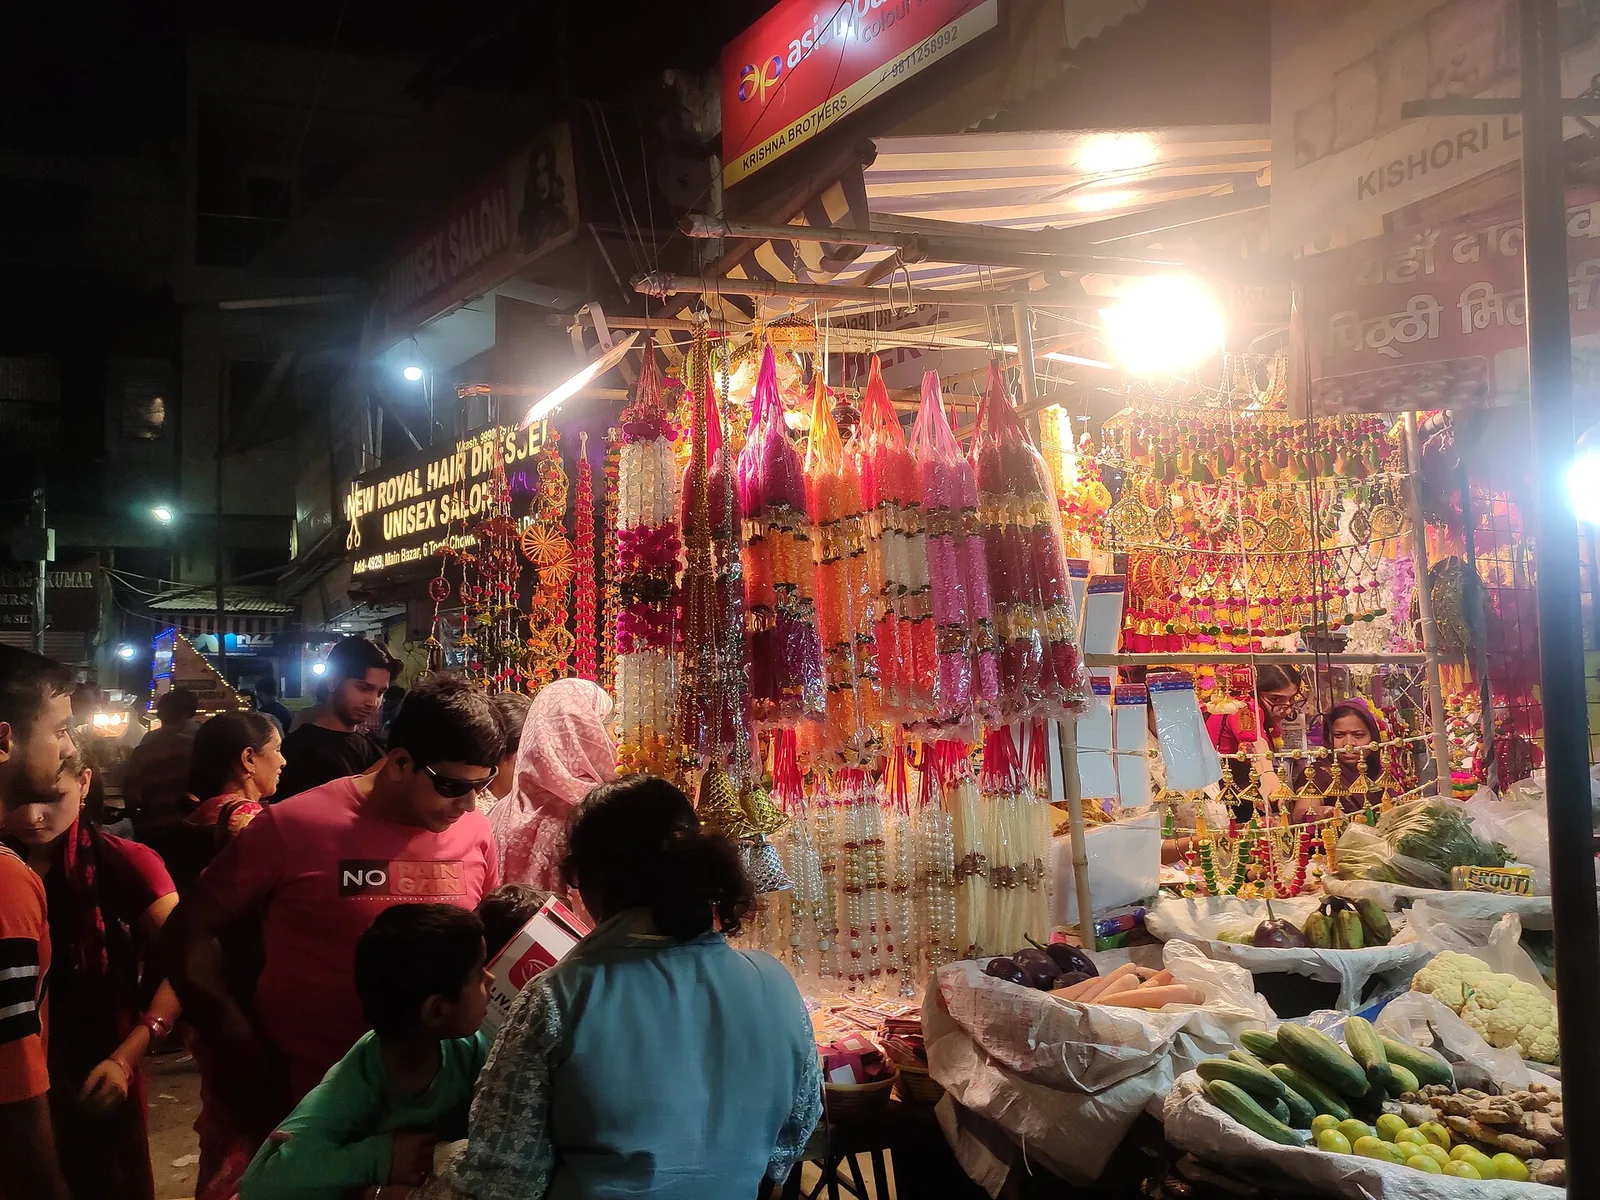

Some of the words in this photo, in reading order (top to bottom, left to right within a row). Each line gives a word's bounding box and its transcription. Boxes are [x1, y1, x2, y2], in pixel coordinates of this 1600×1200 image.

[891, 26, 959, 78] 9811258992
[743, 137, 787, 171] KRISHNA
[788, 95, 848, 142] BROTHERS
[1357, 121, 1490, 201] KISHORI
[448, 188, 508, 277] SALON
[347, 485, 375, 521] NEW
[377, 468, 423, 511] ROYAL
[427, 452, 467, 491] HAIR
[383, 499, 437, 541] UNISEX
[440, 481, 494, 525] SALON
[45, 571, 93, 588] KUMAR
[384, 550, 400, 566] Main
[400, 547, 422, 562] Bazar,
[423, 542, 428, 557] 6
[343, 869, 387, 887] NO
[399, 863, 459, 879] PAIN
[398, 878, 460, 894] GAIN
[1468, 867, 1530, 895] FROOTI
